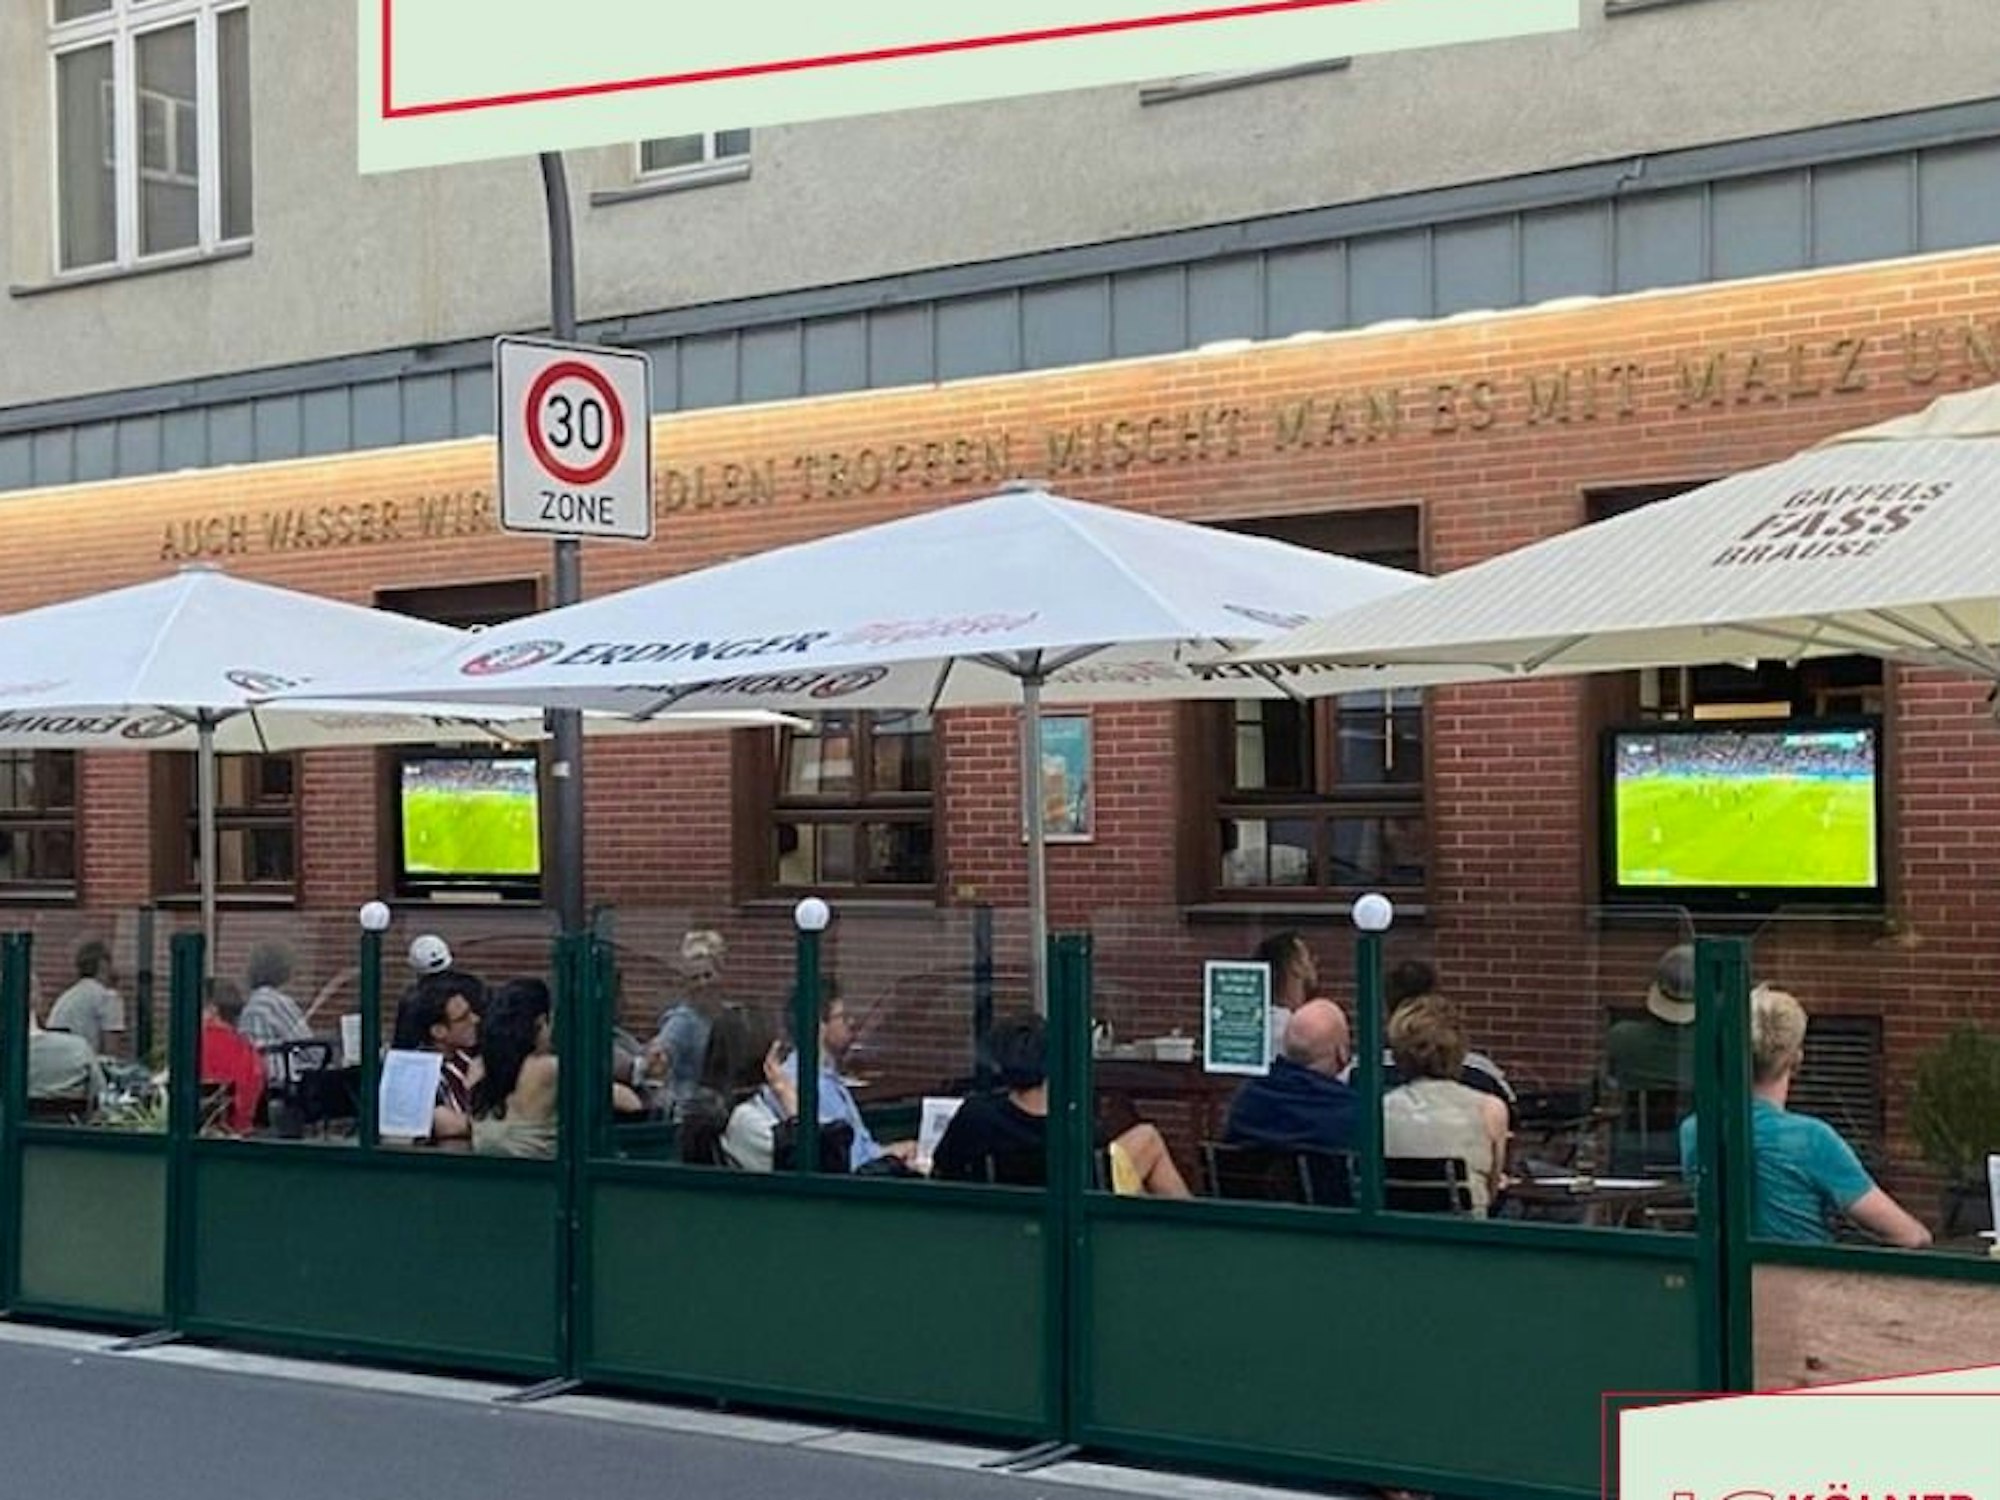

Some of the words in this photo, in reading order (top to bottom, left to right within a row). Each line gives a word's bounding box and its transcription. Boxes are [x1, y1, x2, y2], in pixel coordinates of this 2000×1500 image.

[548, 395, 604, 450] 30
[159, 514, 248, 560] AUCH
[262, 500, 402, 549] WASSER
[1043, 402, 1249, 476] MISCHT
[1272, 386, 1401, 451] MAN
[1430, 374, 1496, 434] ES
[1525, 358, 1645, 427] MIT
[1675, 334, 1869, 410] MALZ
[540, 490, 615, 525] ZONE
[1784, 481, 1953, 509] GAFFELS
[1740, 503, 1927, 541] FASS
[1712, 537, 1888, 567] BRAUSE
[552, 630, 830, 665] ERDINGER
